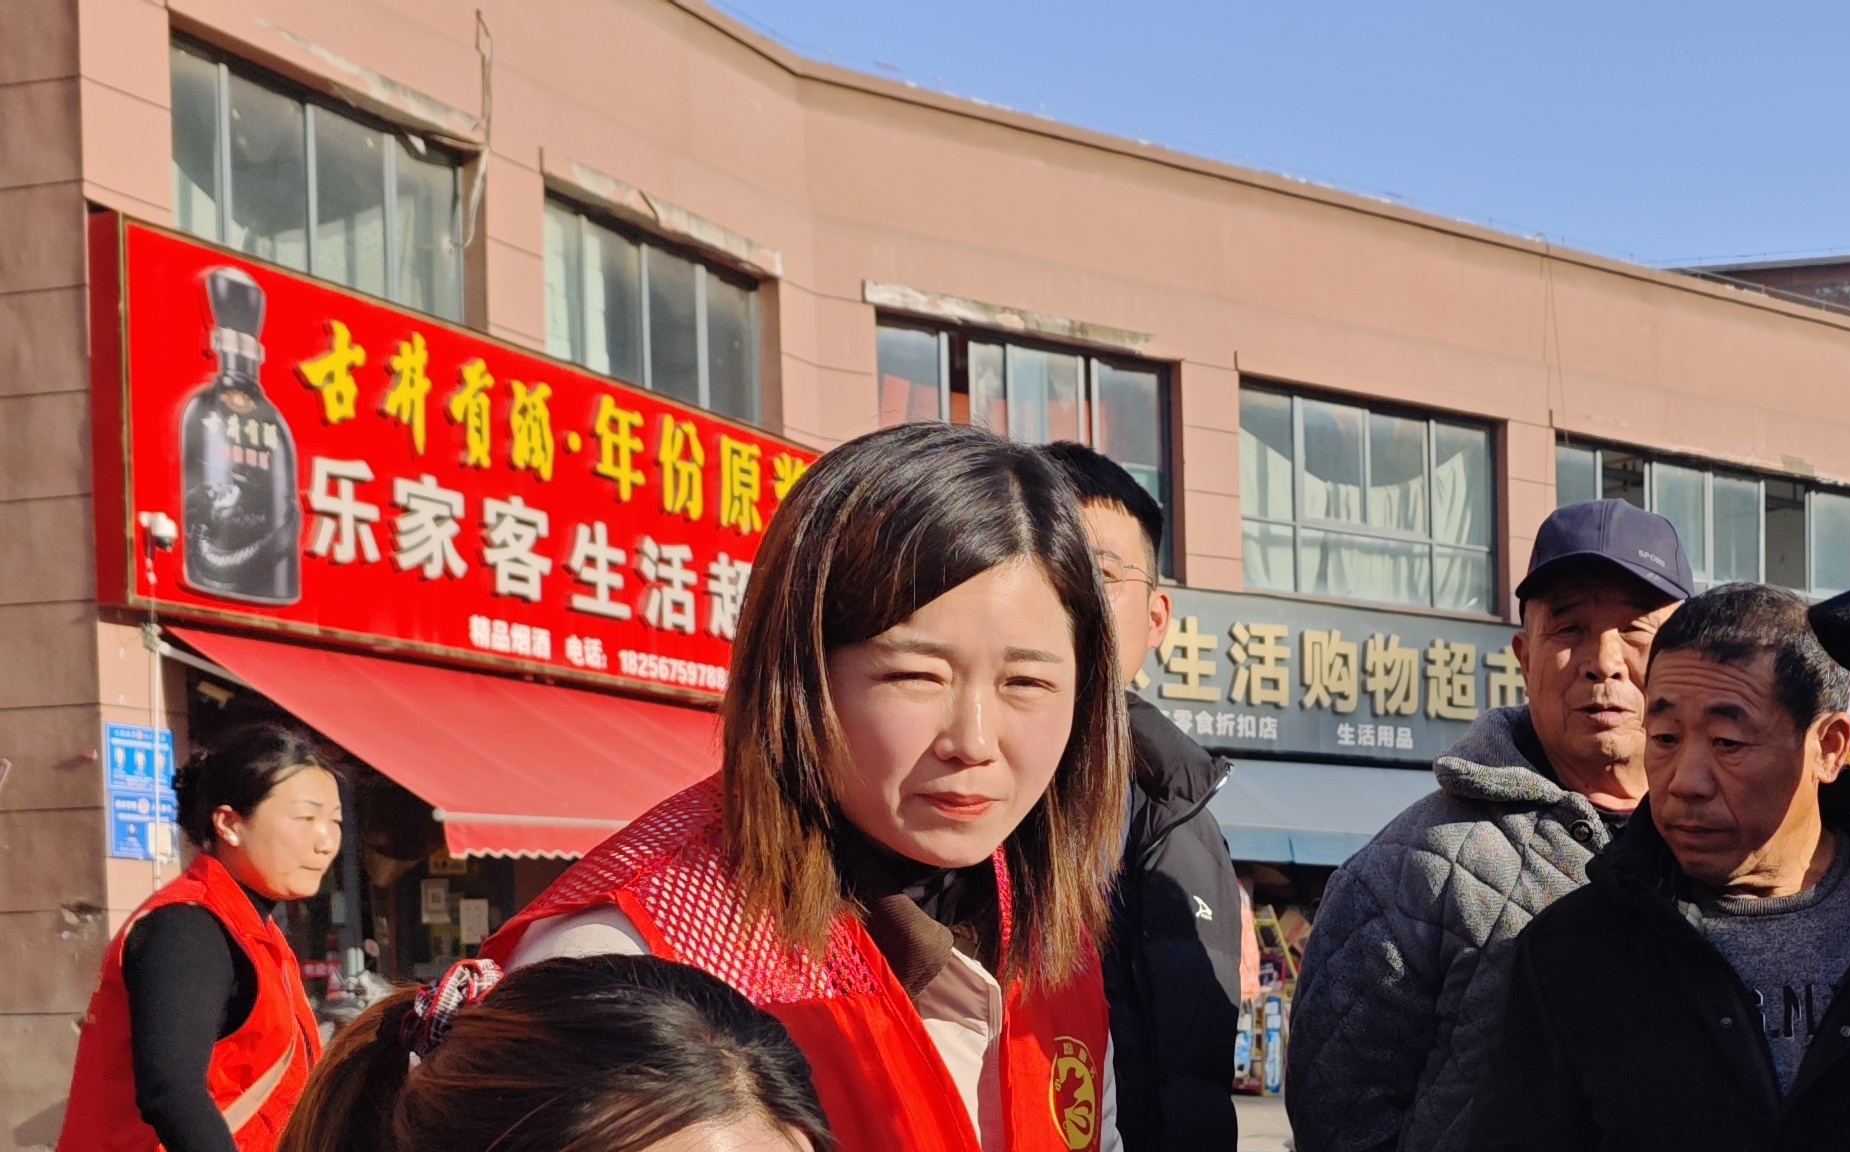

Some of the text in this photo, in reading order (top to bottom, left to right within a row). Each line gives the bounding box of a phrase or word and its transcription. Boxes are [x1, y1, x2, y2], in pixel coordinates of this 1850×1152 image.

[1134, 615, 1530, 722] 生活购物超市
[1161, 709, 1279, 740] 零食折扣店
[1337, 723, 1414, 750] 生活用品
